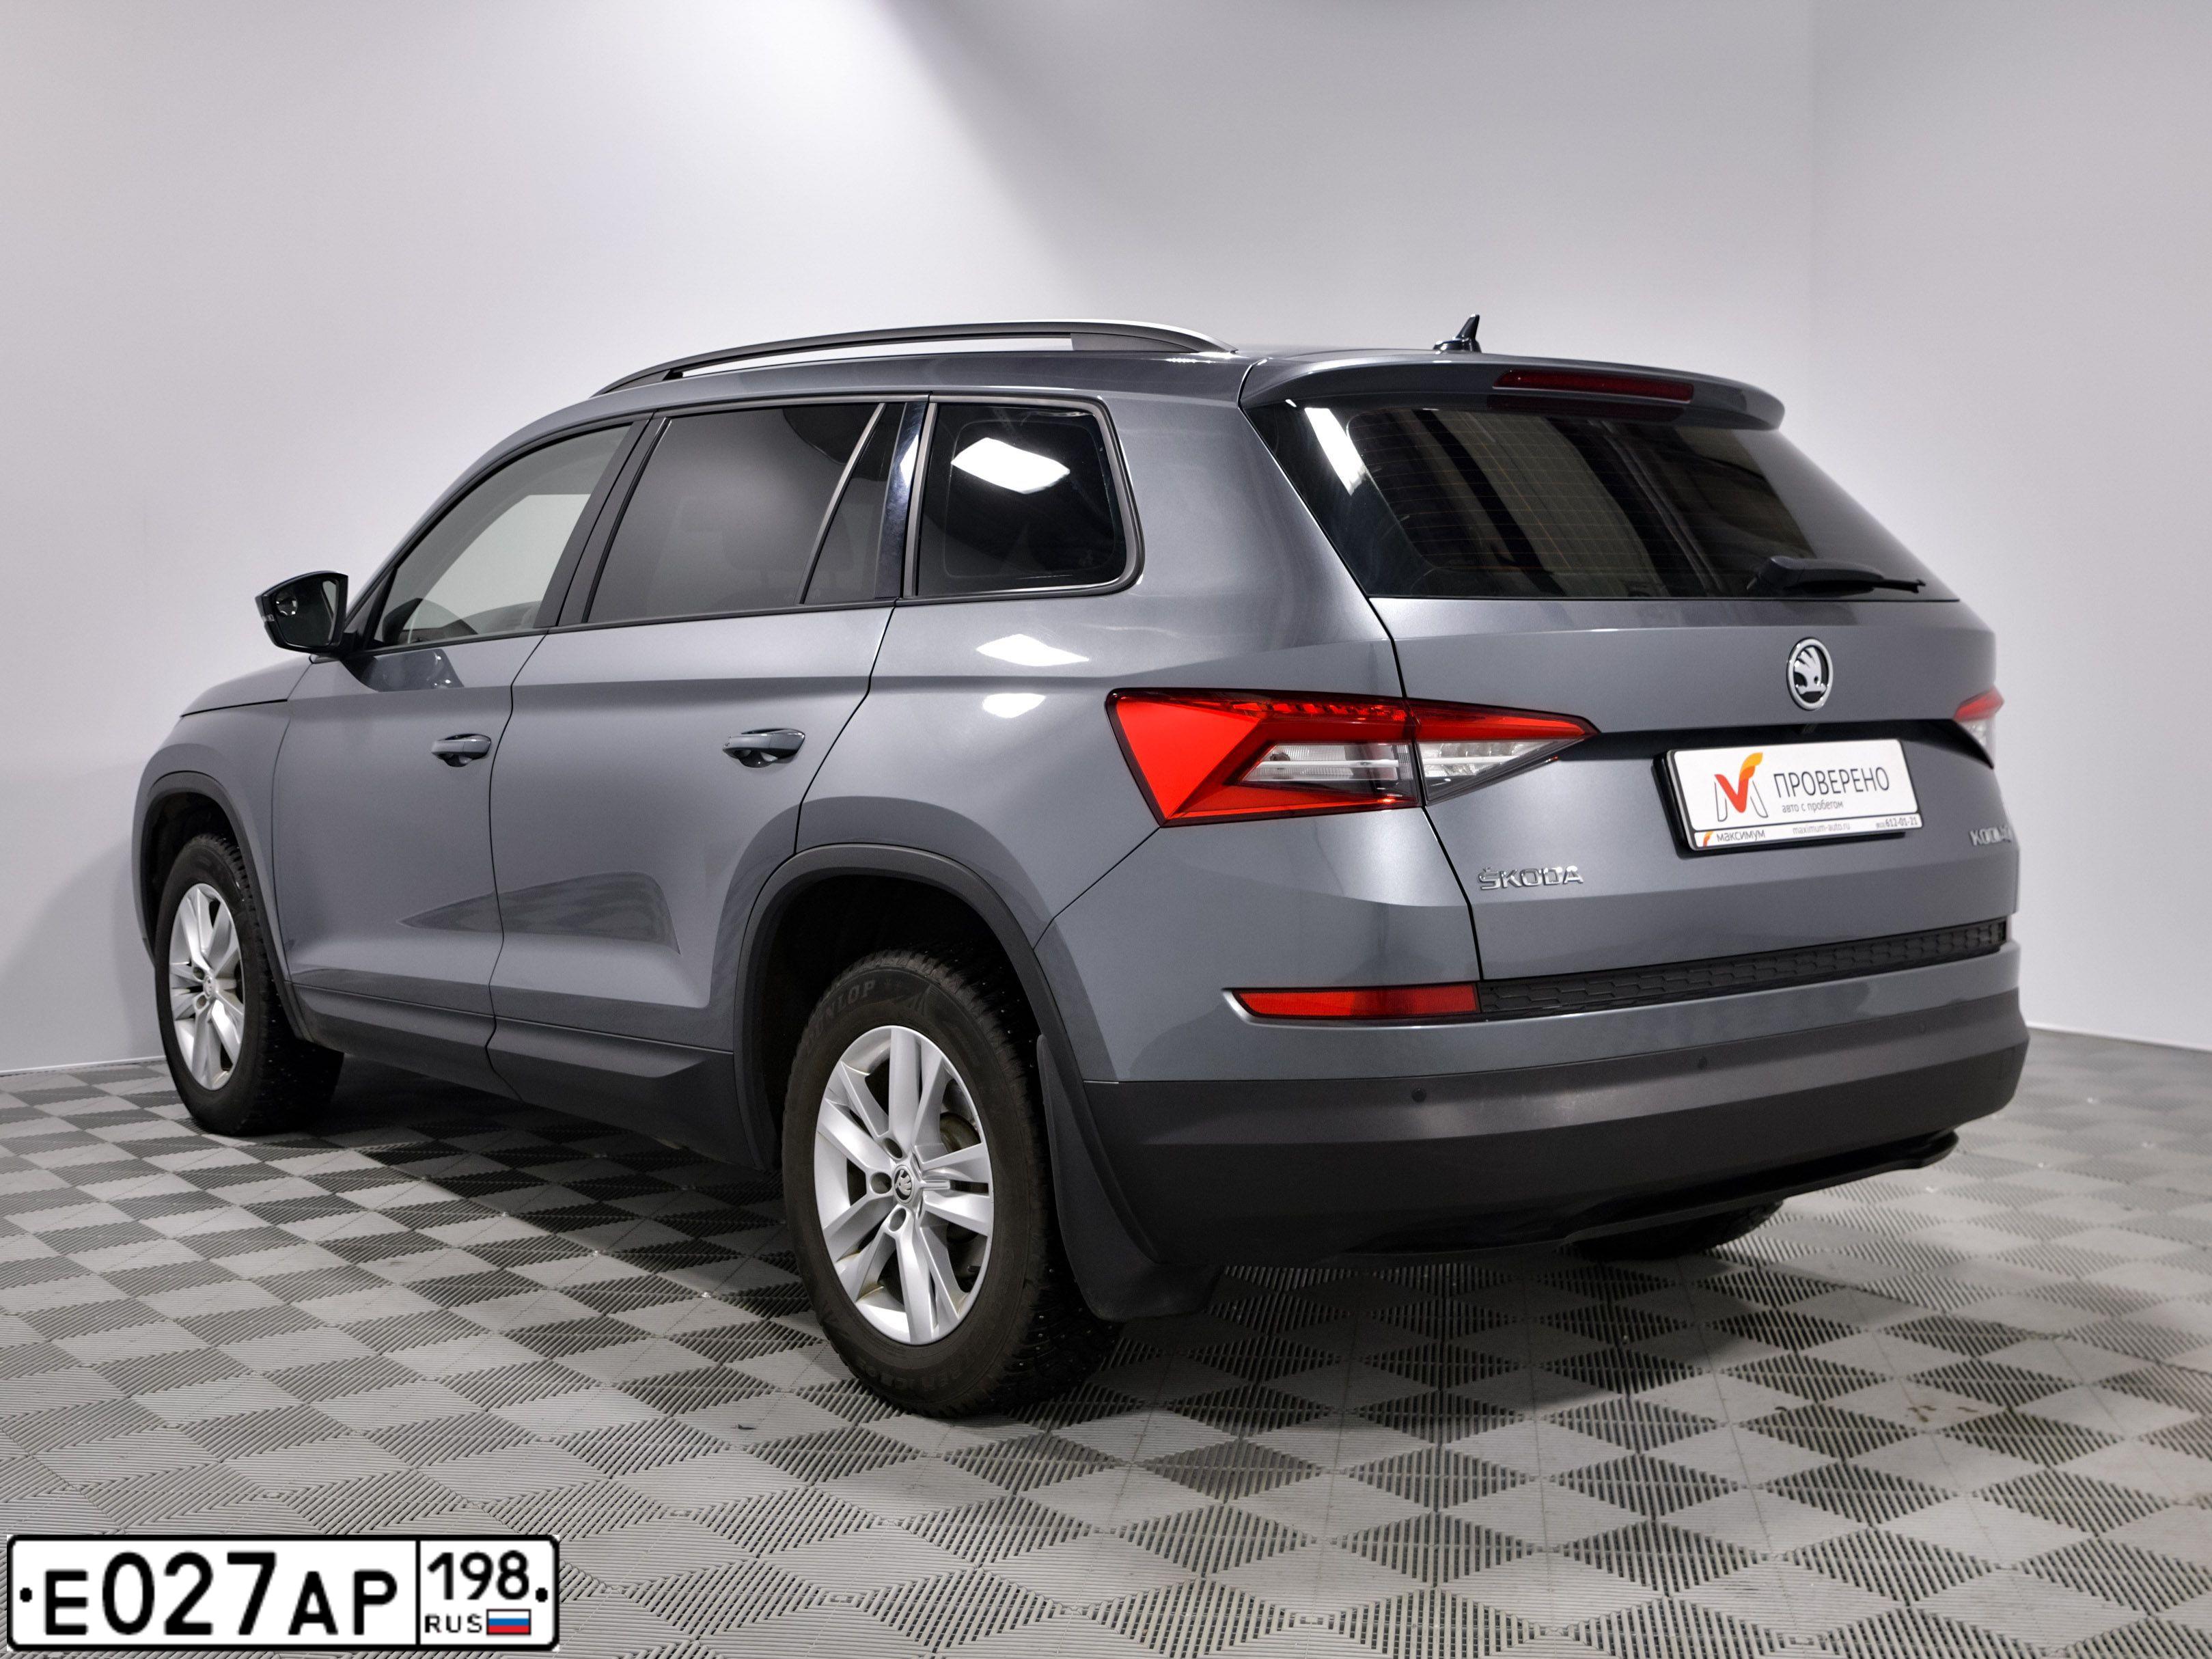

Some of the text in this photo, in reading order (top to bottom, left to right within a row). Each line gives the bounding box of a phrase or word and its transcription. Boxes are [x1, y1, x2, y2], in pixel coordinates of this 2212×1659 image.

[1773, 767, 1890, 798] ПРОВЕРЕНО
[1782, 799, 1843, 813] авто с пробегом
[1793, 822, 1851, 835] maximum-auto.ru
[1716, 830, 1766, 842] максимум
[1478, 865, 1584, 891] ŠKODA
